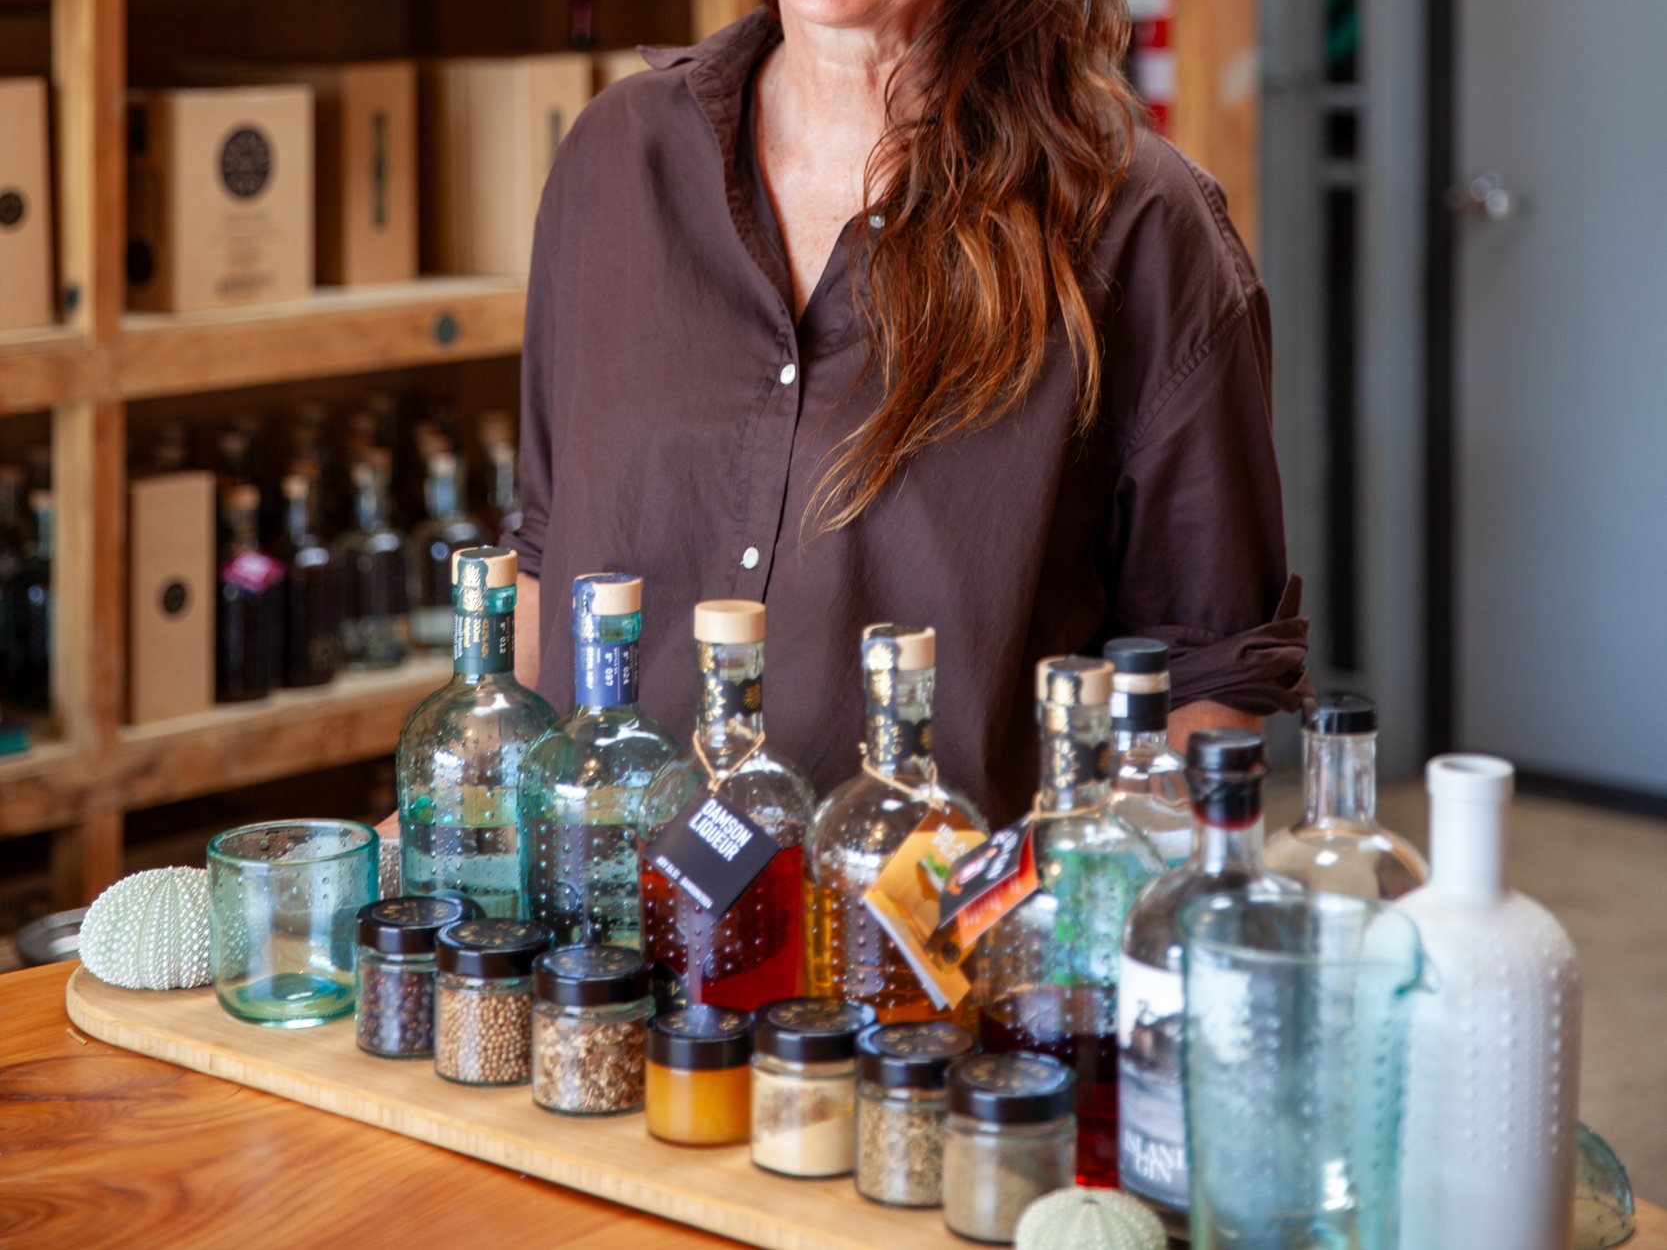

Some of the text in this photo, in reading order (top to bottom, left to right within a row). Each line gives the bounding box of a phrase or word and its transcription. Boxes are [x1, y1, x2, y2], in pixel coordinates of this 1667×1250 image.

[688, 812, 740, 862] LIQUEUR
[701, 798, 753, 848] DAMSON
[1135, 1156, 1171, 1184] GIN
